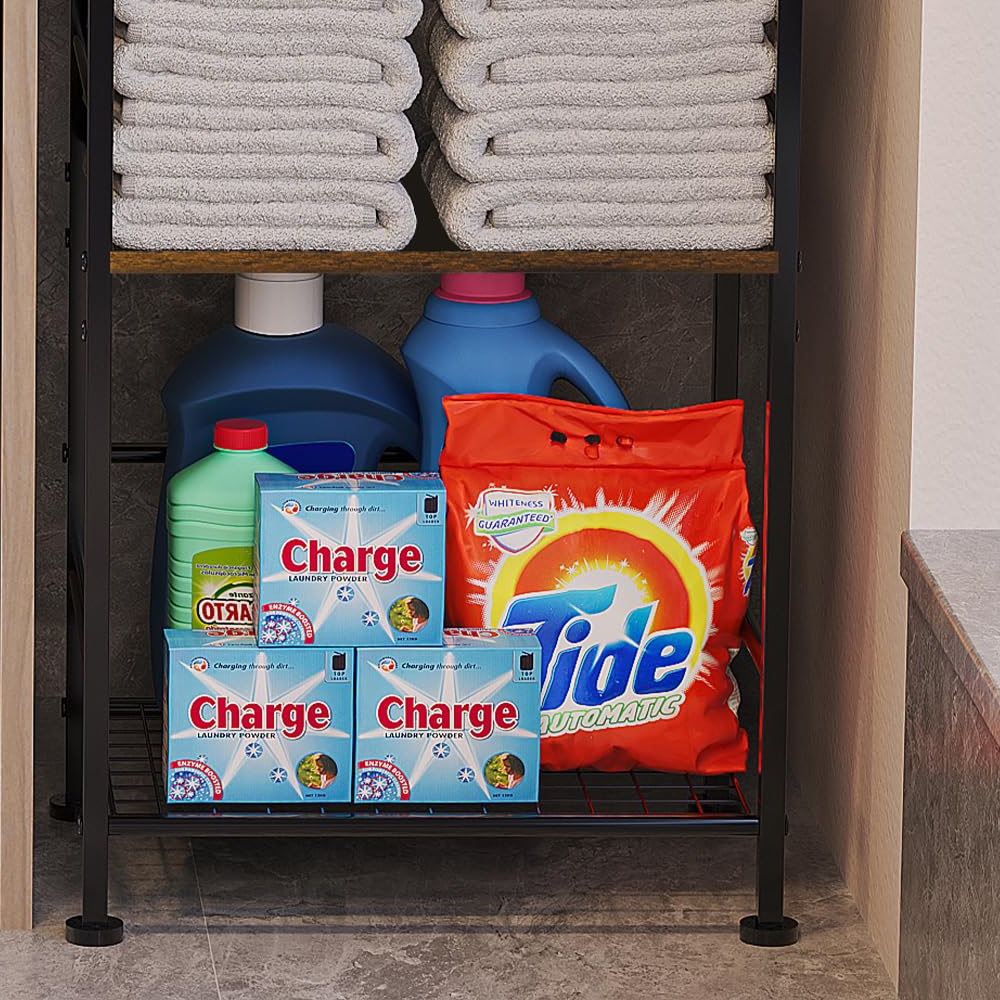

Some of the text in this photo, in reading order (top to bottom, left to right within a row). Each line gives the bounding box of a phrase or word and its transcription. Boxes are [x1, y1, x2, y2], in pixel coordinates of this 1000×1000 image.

[305, 504, 339, 514] Charging
[340, 504, 367, 514] through
[488, 498, 544, 508] WHITENESS
[478, 513, 551, 530] GUARANTEED
[281, 537, 424, 583] Charge
[288, 575, 368, 583] LAUNDRY POWDER
[295, 611, 313, 639] BOOSTED
[501, 582, 694, 711] Tide
[213, 661, 247, 671] Charging
[248, 661, 275, 671] through
[401, 661, 435, 671] Charging
[436, 661, 463, 671] through
[189, 695, 332, 740] Charge
[376, 695, 519, 740] Charge
[204, 767, 222, 795] BOOSTED
[391, 767, 410, 795] BOOSTED
